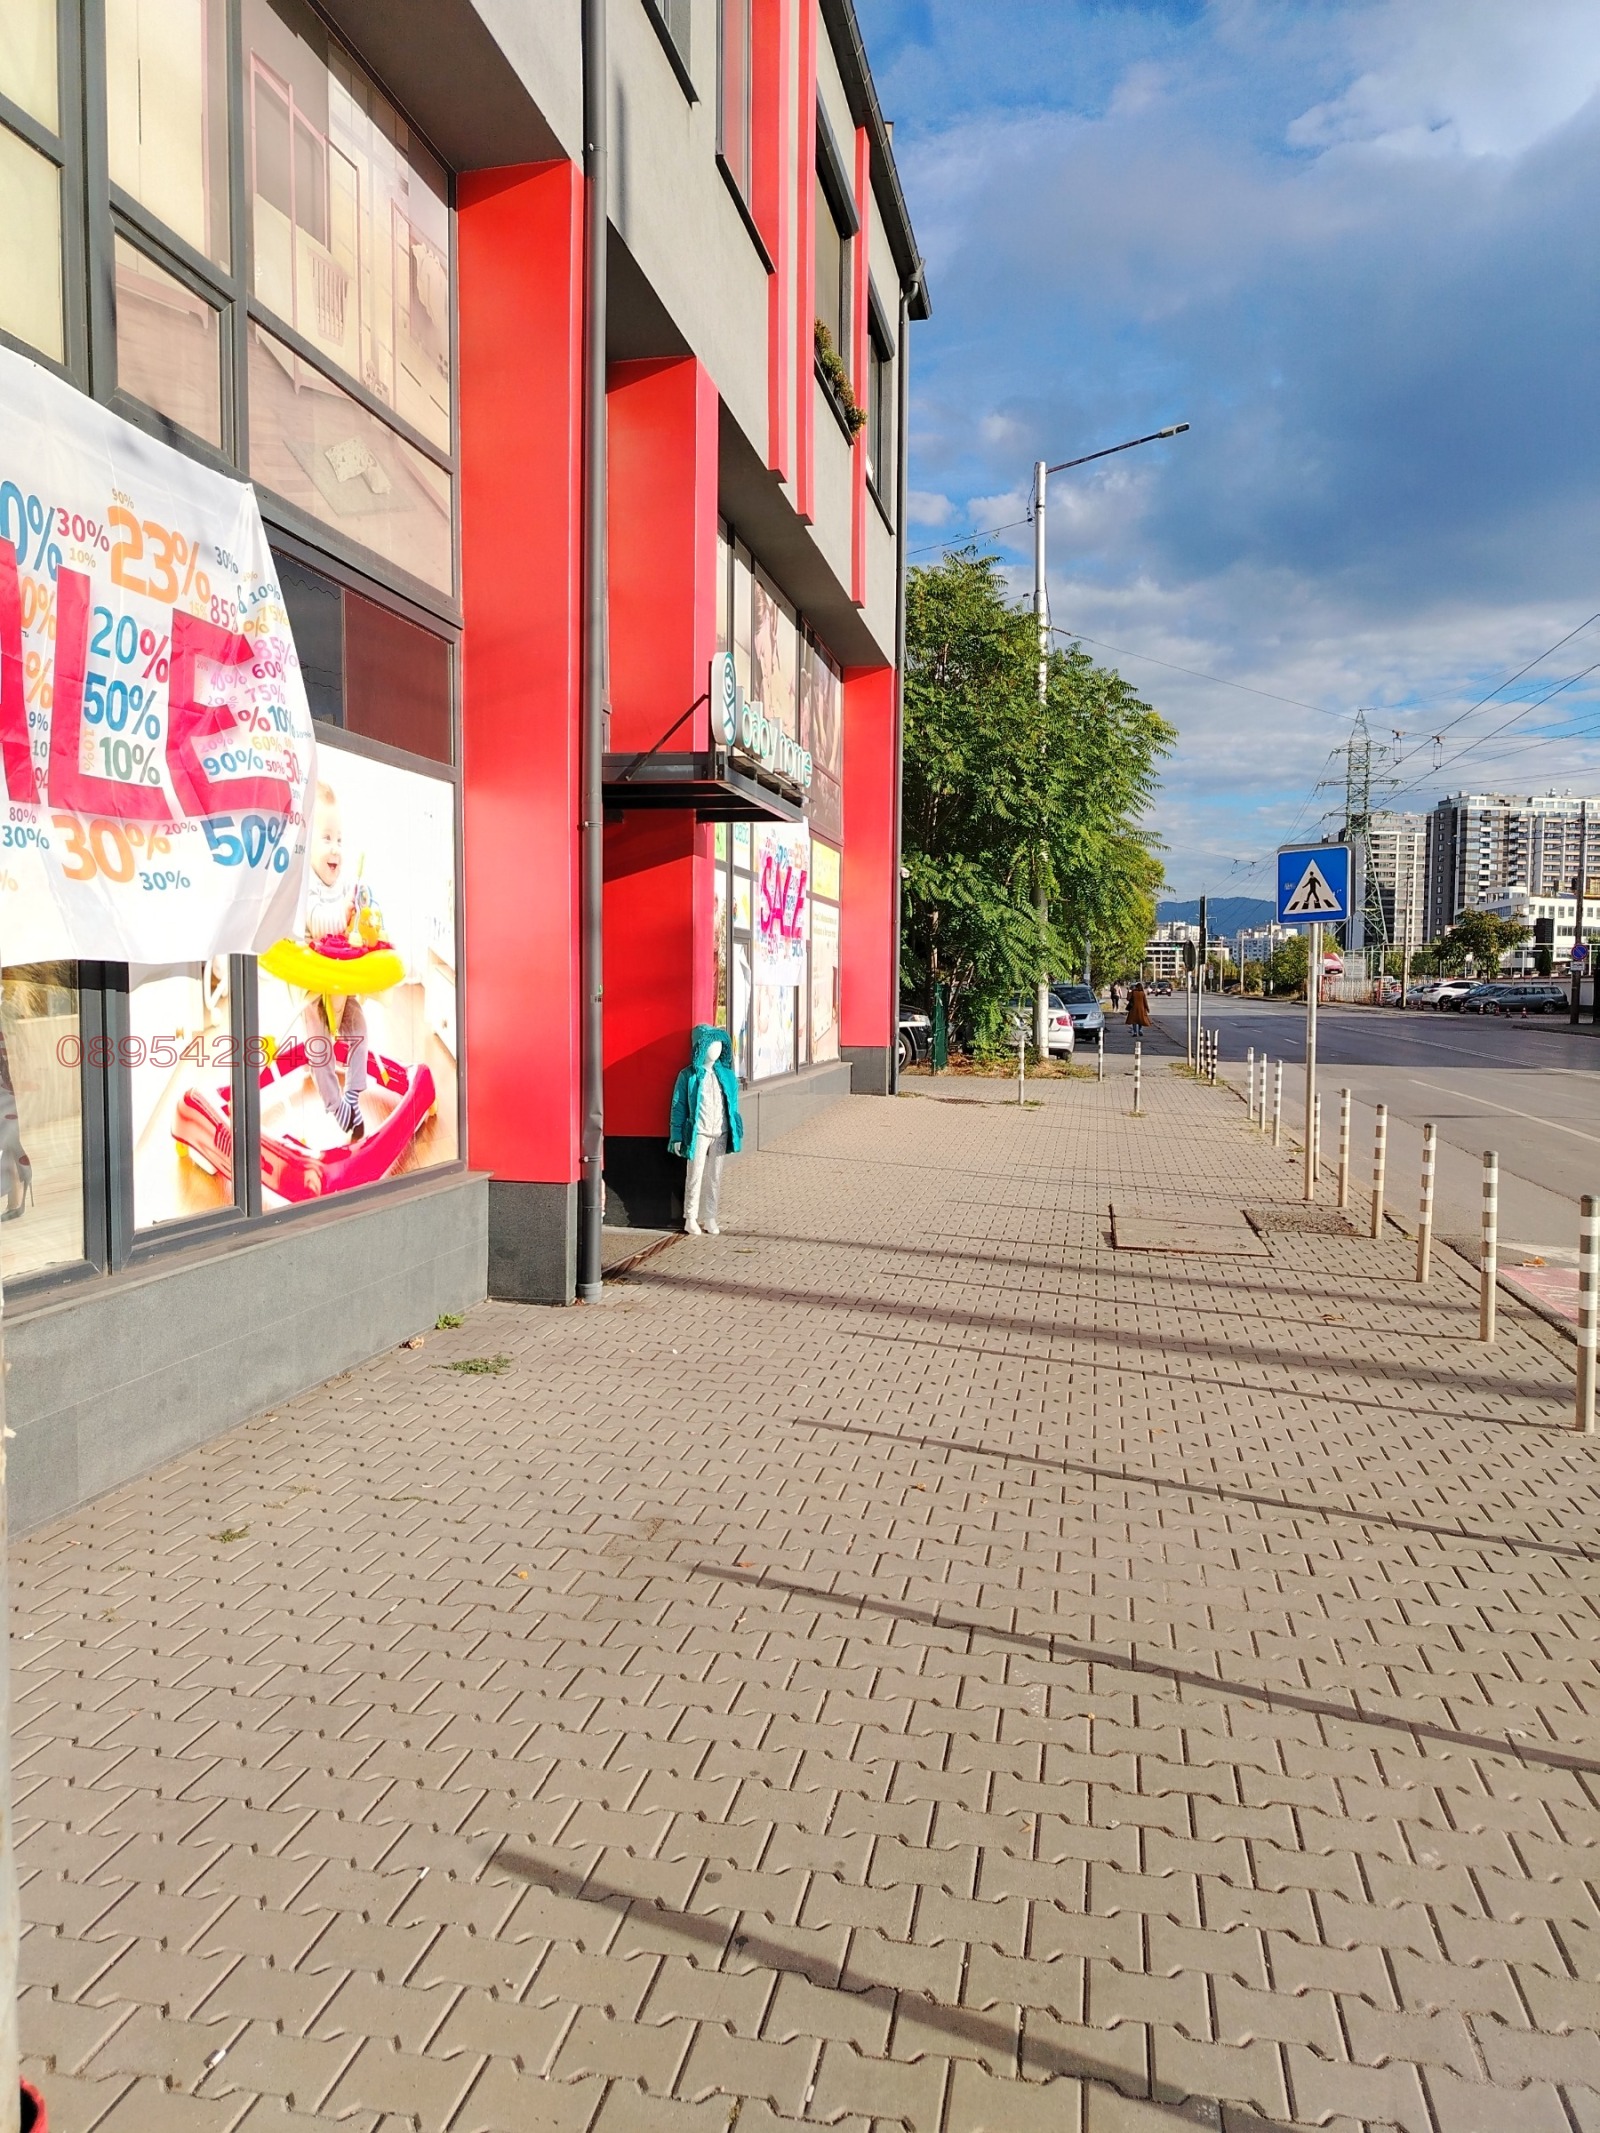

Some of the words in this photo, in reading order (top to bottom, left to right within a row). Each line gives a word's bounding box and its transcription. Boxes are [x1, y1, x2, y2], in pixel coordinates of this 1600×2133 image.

[56, 508, 109, 552] 30%
[70, 547, 96, 568] 10%
[107, 505, 211, 604] 23%
[214, 546, 239, 574] 30%
[249, 583, 281, 605] 10%
[210, 594, 239, 633] 85%
[90, 606, 169, 683] 20%
[254, 636, 298, 667] 85%
[252, 660, 287, 683] 60%
[83, 671, 161, 740] 50%
[245, 683, 286, 705] 75%
[28, 711, 49, 731] 9%
[267, 705, 295, 738] 10%
[252, 735, 283, 753] 60%
[99, 736, 161, 785] 10%
[203, 748, 264, 776] 90%
[265, 759, 285, 775] 50%
[9, 806, 37, 824] 80%
[162, 820, 198, 836] 20%
[2, 825, 50, 850] 30%
[51, 814, 171, 883] 30%
[200, 814, 290, 874] 50%
[139, 869, 191, 891] 30%
[760, 856, 807, 938] SALE
